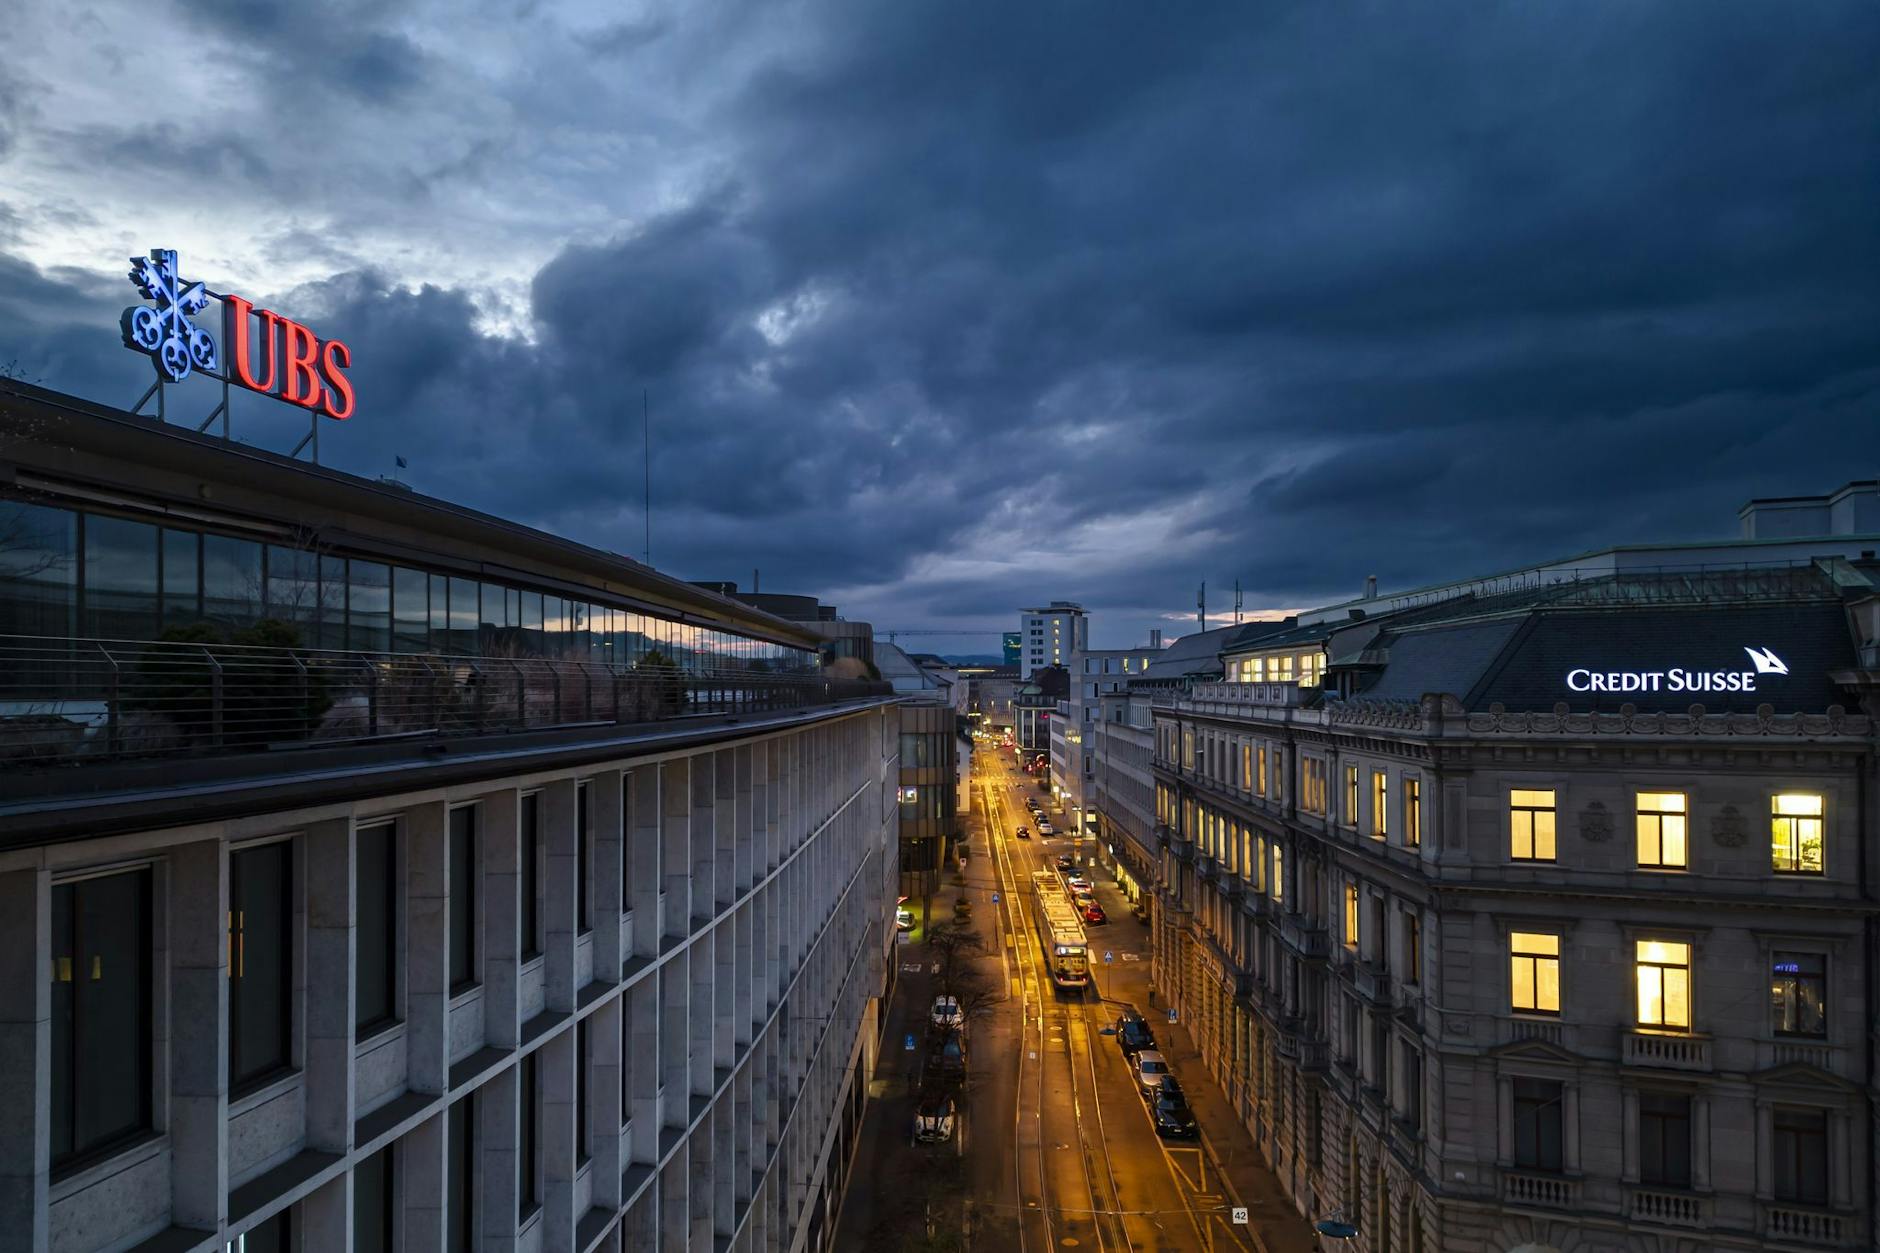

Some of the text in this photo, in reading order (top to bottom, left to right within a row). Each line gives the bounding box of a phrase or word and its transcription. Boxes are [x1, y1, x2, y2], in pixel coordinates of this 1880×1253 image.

[227, 294, 356, 421] UBS
[1567, 668, 1756, 691] CREDIT SUISSE
[1234, 1211, 1247, 1221] 42
